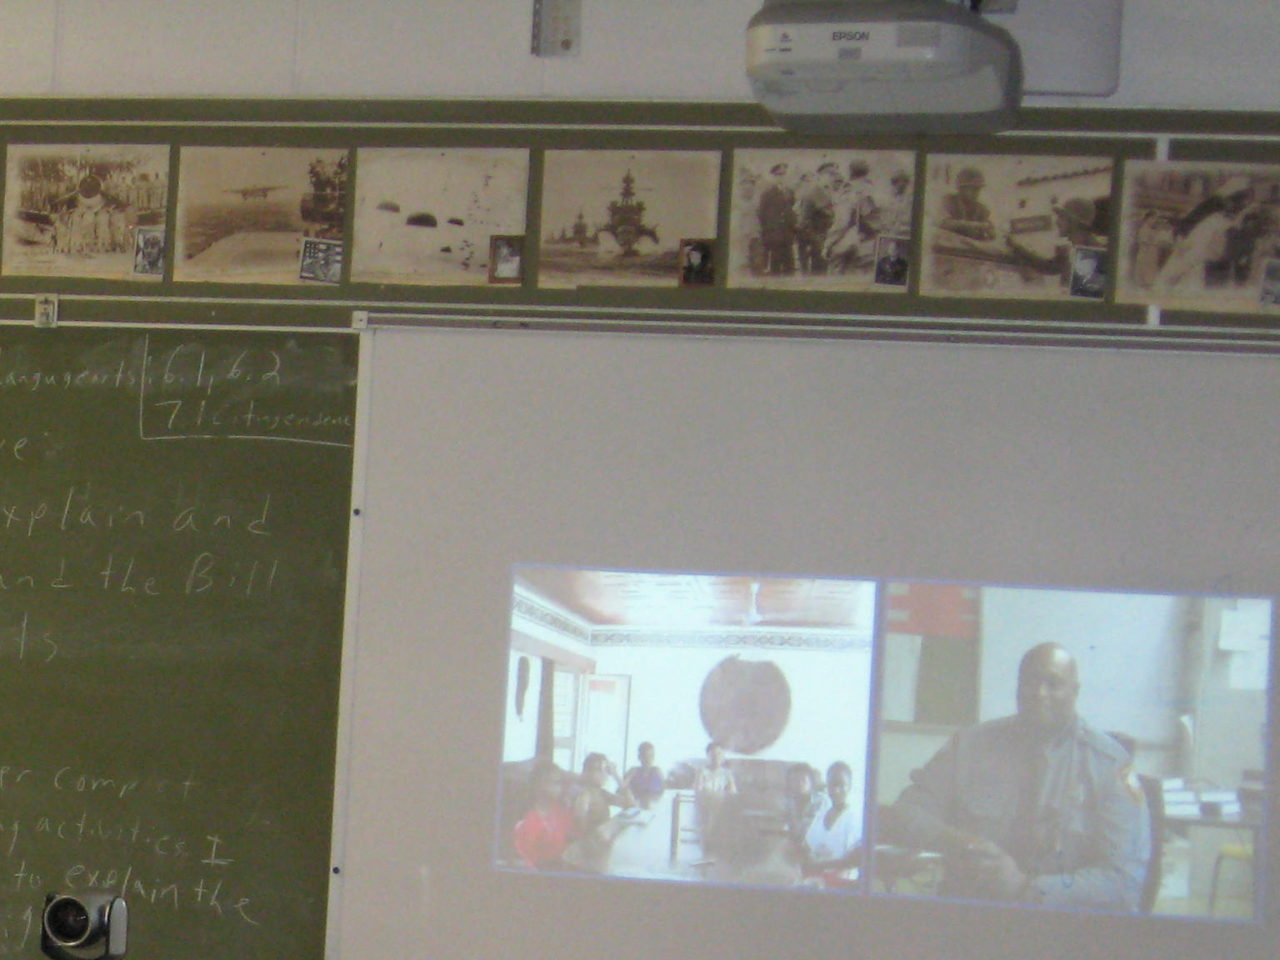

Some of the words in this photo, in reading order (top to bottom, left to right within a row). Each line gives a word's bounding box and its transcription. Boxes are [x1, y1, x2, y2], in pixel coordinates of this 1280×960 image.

[832, 31, 870, 41] EPSON
[172, 494, 272, 535] and
[100, 556, 160, 597] the
[184, 551, 279, 597] Bill
[13, 859, 41, 893] to
[65, 864, 179, 911] explain
[194, 877, 262, 927] the
